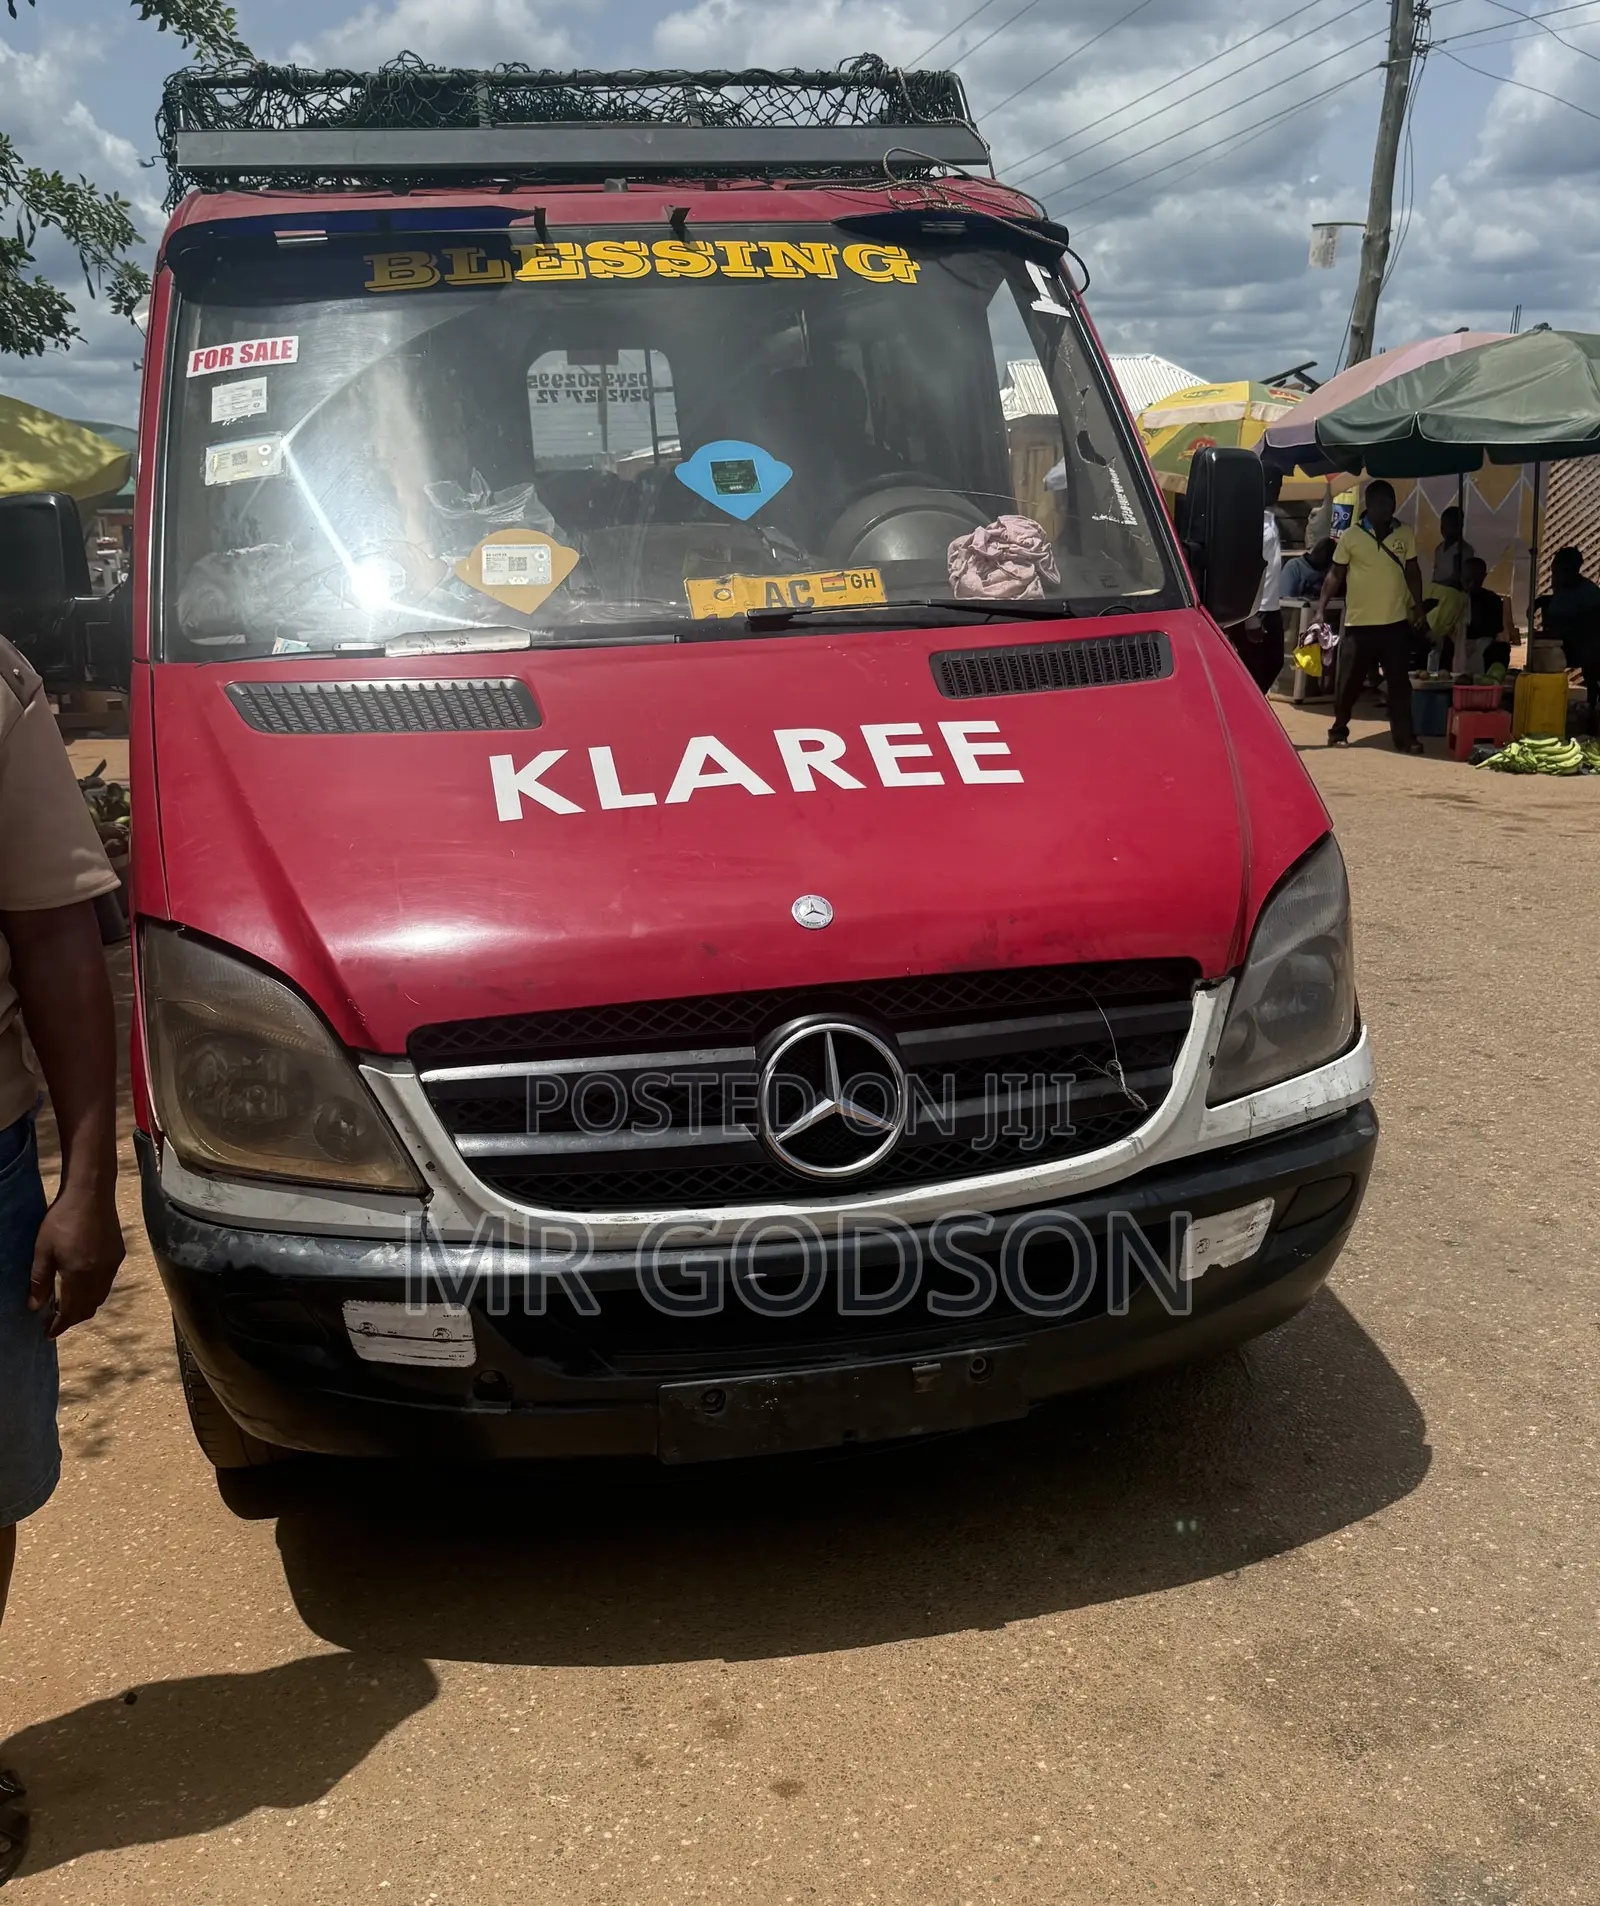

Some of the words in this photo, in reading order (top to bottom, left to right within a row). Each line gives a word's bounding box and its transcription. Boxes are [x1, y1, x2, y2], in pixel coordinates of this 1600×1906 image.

[364, 240, 920, 291] BLESSING
[192, 347, 234, 372] FOR
[240, 339, 293, 364] SALE
[765, 579, 815, 608] AC
[850, 573, 876, 589] GH
[489, 720, 1025, 822] KLAREE
